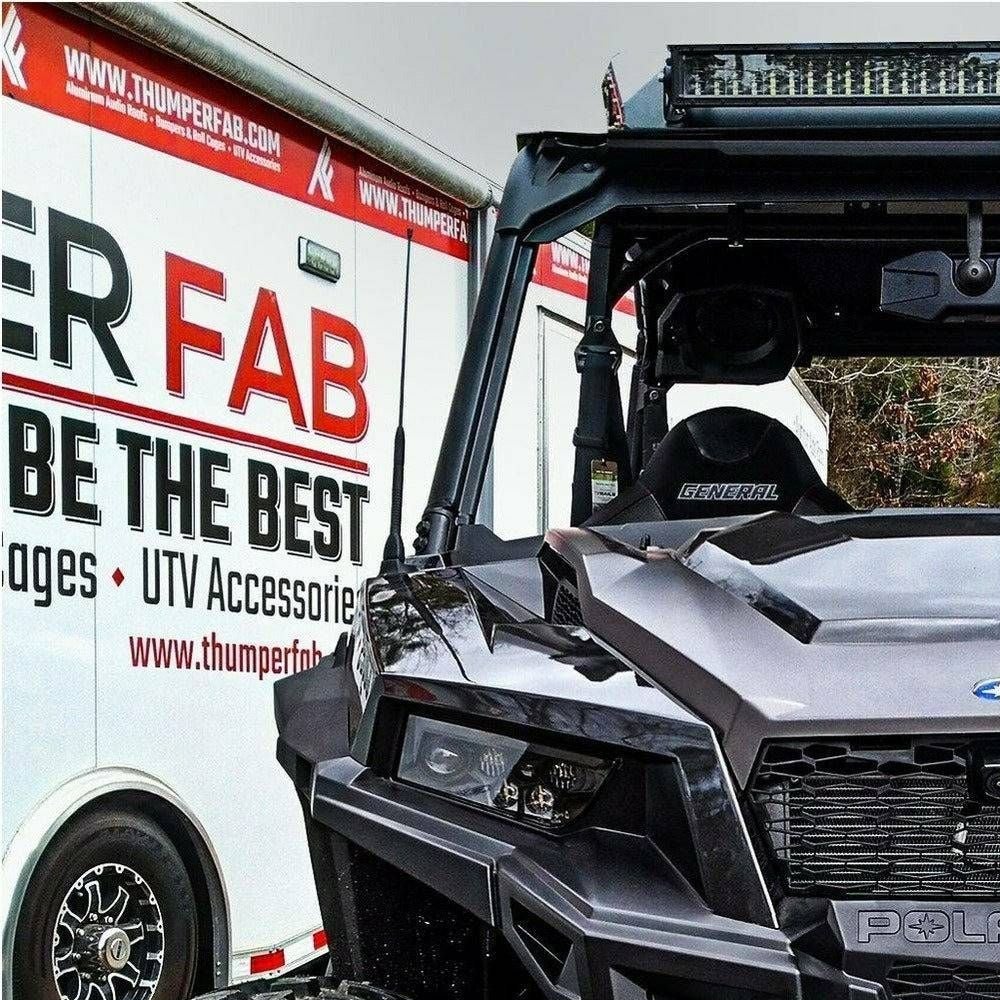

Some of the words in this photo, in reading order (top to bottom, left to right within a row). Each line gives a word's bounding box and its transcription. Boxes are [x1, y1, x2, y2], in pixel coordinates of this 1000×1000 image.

[64, 44, 281, 158] WWW.THUMPERFAB.COM
[164, 250, 370, 443] FAB
[8, 403, 101, 526] BE
[115, 428, 232, 545] THE
[247, 458, 370, 566] BEST
[677, 482, 779, 500] GENERAL
[2, 531, 97, 608] ages
[142, 546, 199, 609] UTV
[206, 556, 359, 626] Accessorie
